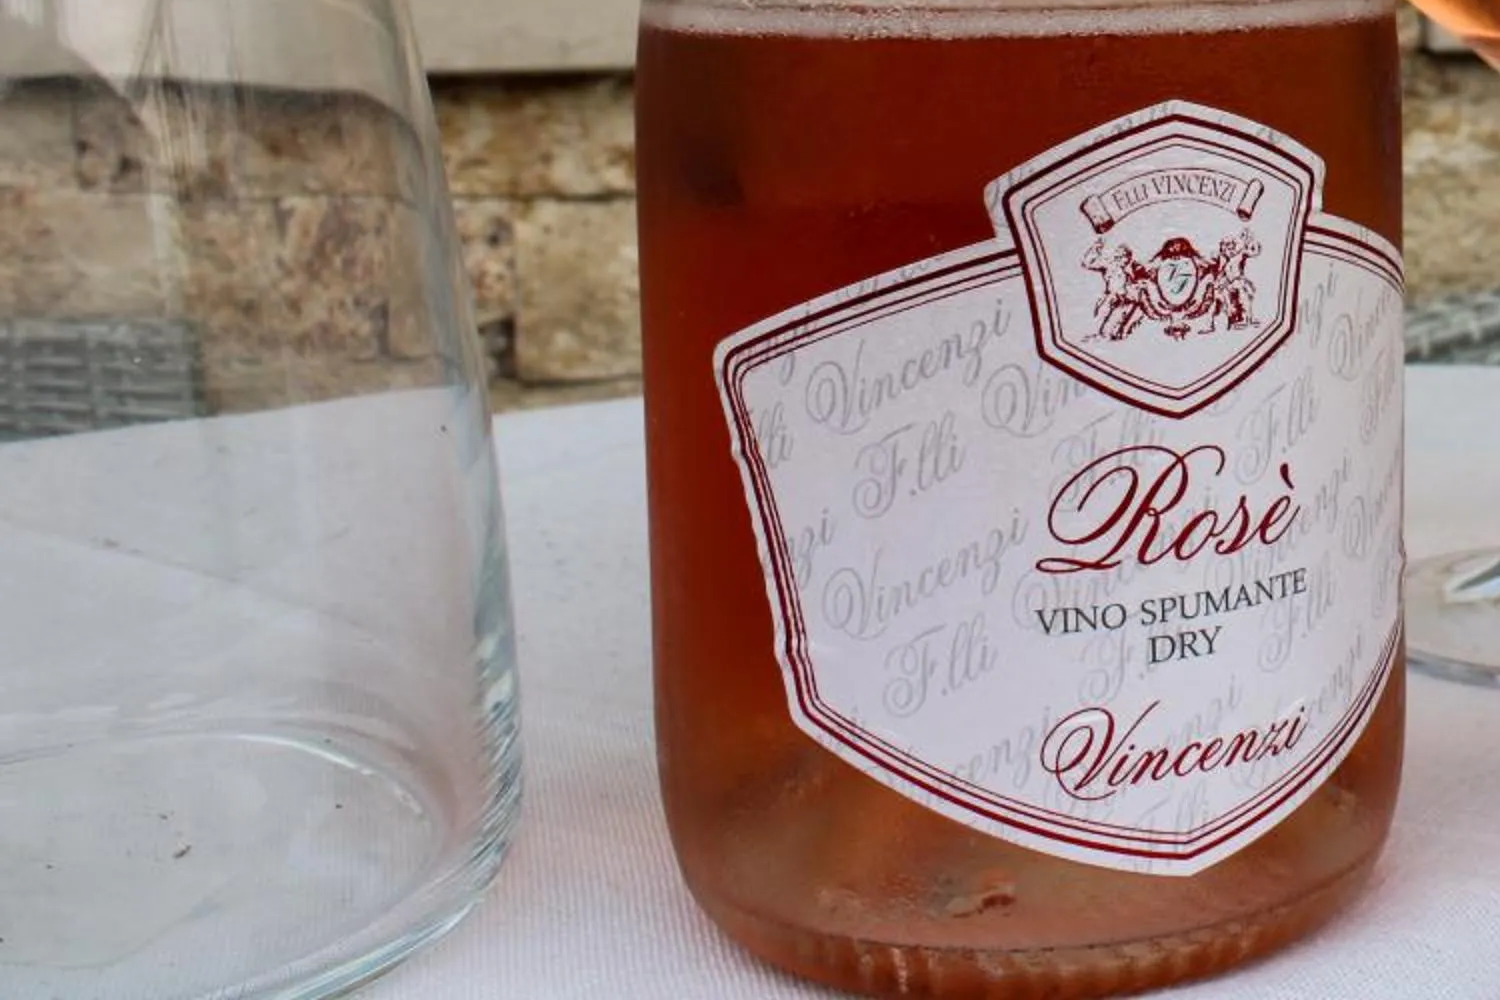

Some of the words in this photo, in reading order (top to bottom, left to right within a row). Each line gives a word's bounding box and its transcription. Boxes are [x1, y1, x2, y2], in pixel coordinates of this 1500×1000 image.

[1151, 173, 1237, 203] VINCENZI
[805, 297, 1011, 435] Vincenzi
[852, 410, 966, 519] F.lli
[1035, 444, 1301, 575] Rosè
[822, 506, 1029, 641] Vincenzi
[1033, 602, 1128, 636] VINO
[1140, 567, 1308, 627] SPUMANTE
[882, 611, 998, 718] F.lli
[1148, 625, 1224, 665] DRY
[1040, 699, 1309, 801] Vincenzi
